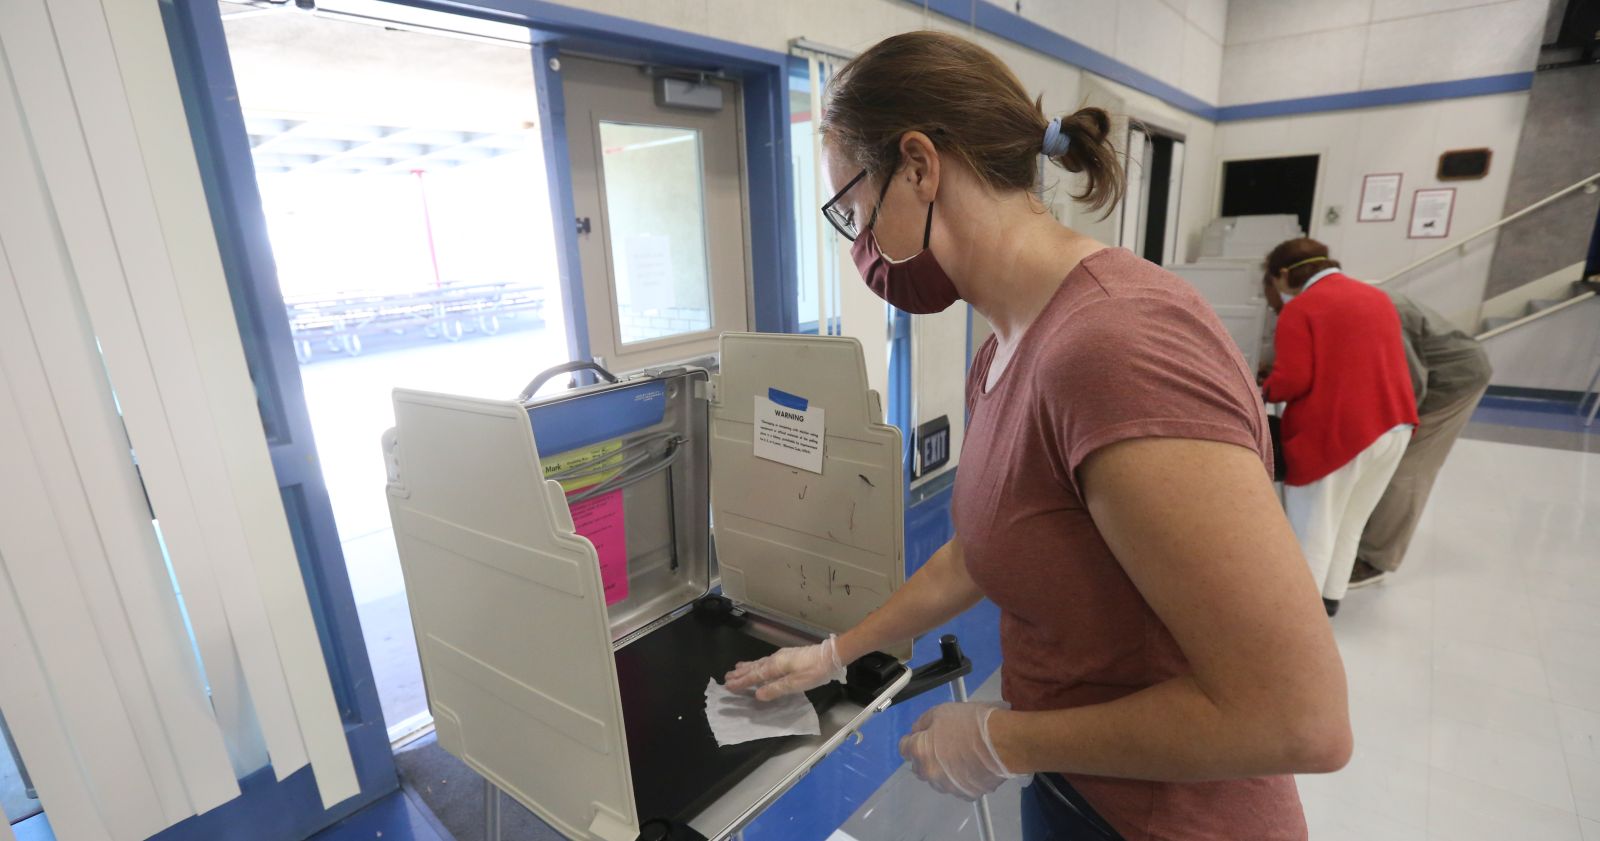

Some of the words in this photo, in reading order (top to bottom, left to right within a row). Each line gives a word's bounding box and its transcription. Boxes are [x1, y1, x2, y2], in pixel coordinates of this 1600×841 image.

[774, 409, 805, 423] WARNING
[924, 430, 947, 467] EXIT
[545, 463, 562, 474] Mark
